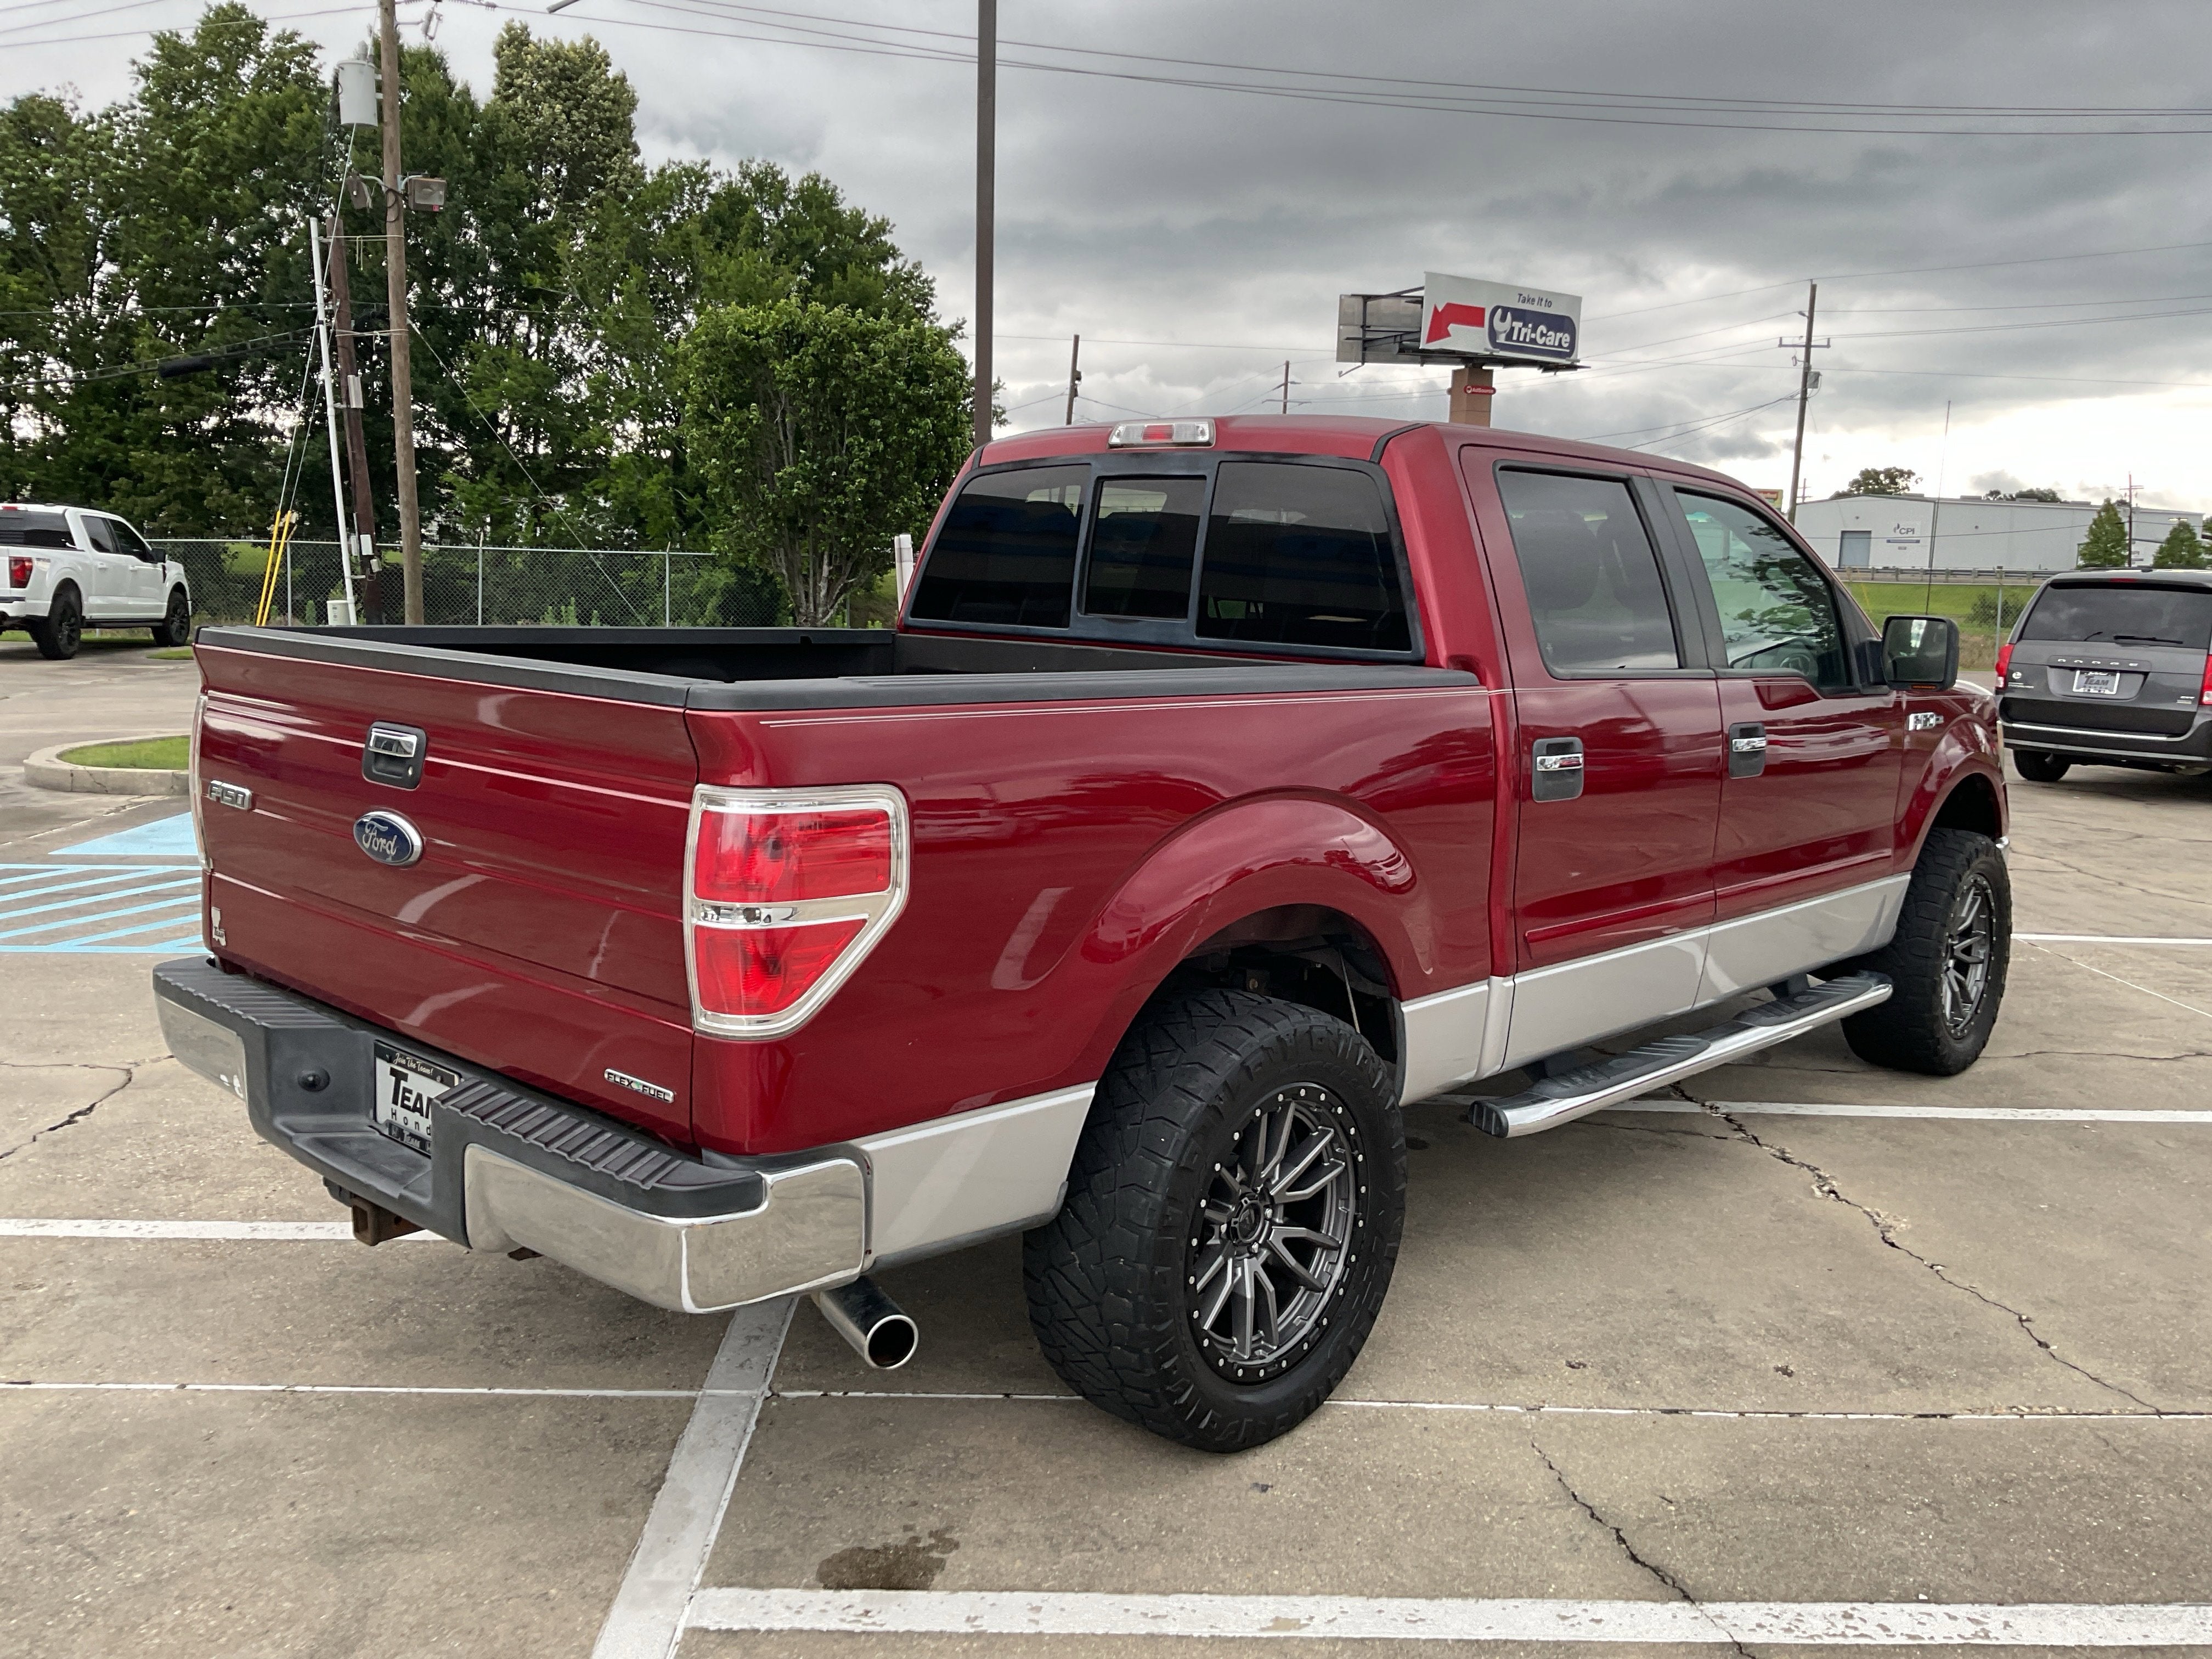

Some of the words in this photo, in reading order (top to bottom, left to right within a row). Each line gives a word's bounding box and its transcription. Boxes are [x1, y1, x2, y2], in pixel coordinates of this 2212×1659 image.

[1517, 293, 1536, 306] Take
[1537, 296, 1543, 307] It
[1544, 298, 1553, 308] to
[1512, 321, 1571, 348] Tri-Care
[362, 820, 399, 856] Ford
[393, 1052, 407, 1065] Join
[406, 1057, 417, 1069] The
[416, 1061, 434, 1076] Team!
[607, 1071, 634, 1090] FLEX
[642, 1084, 670, 1102] FUEL
